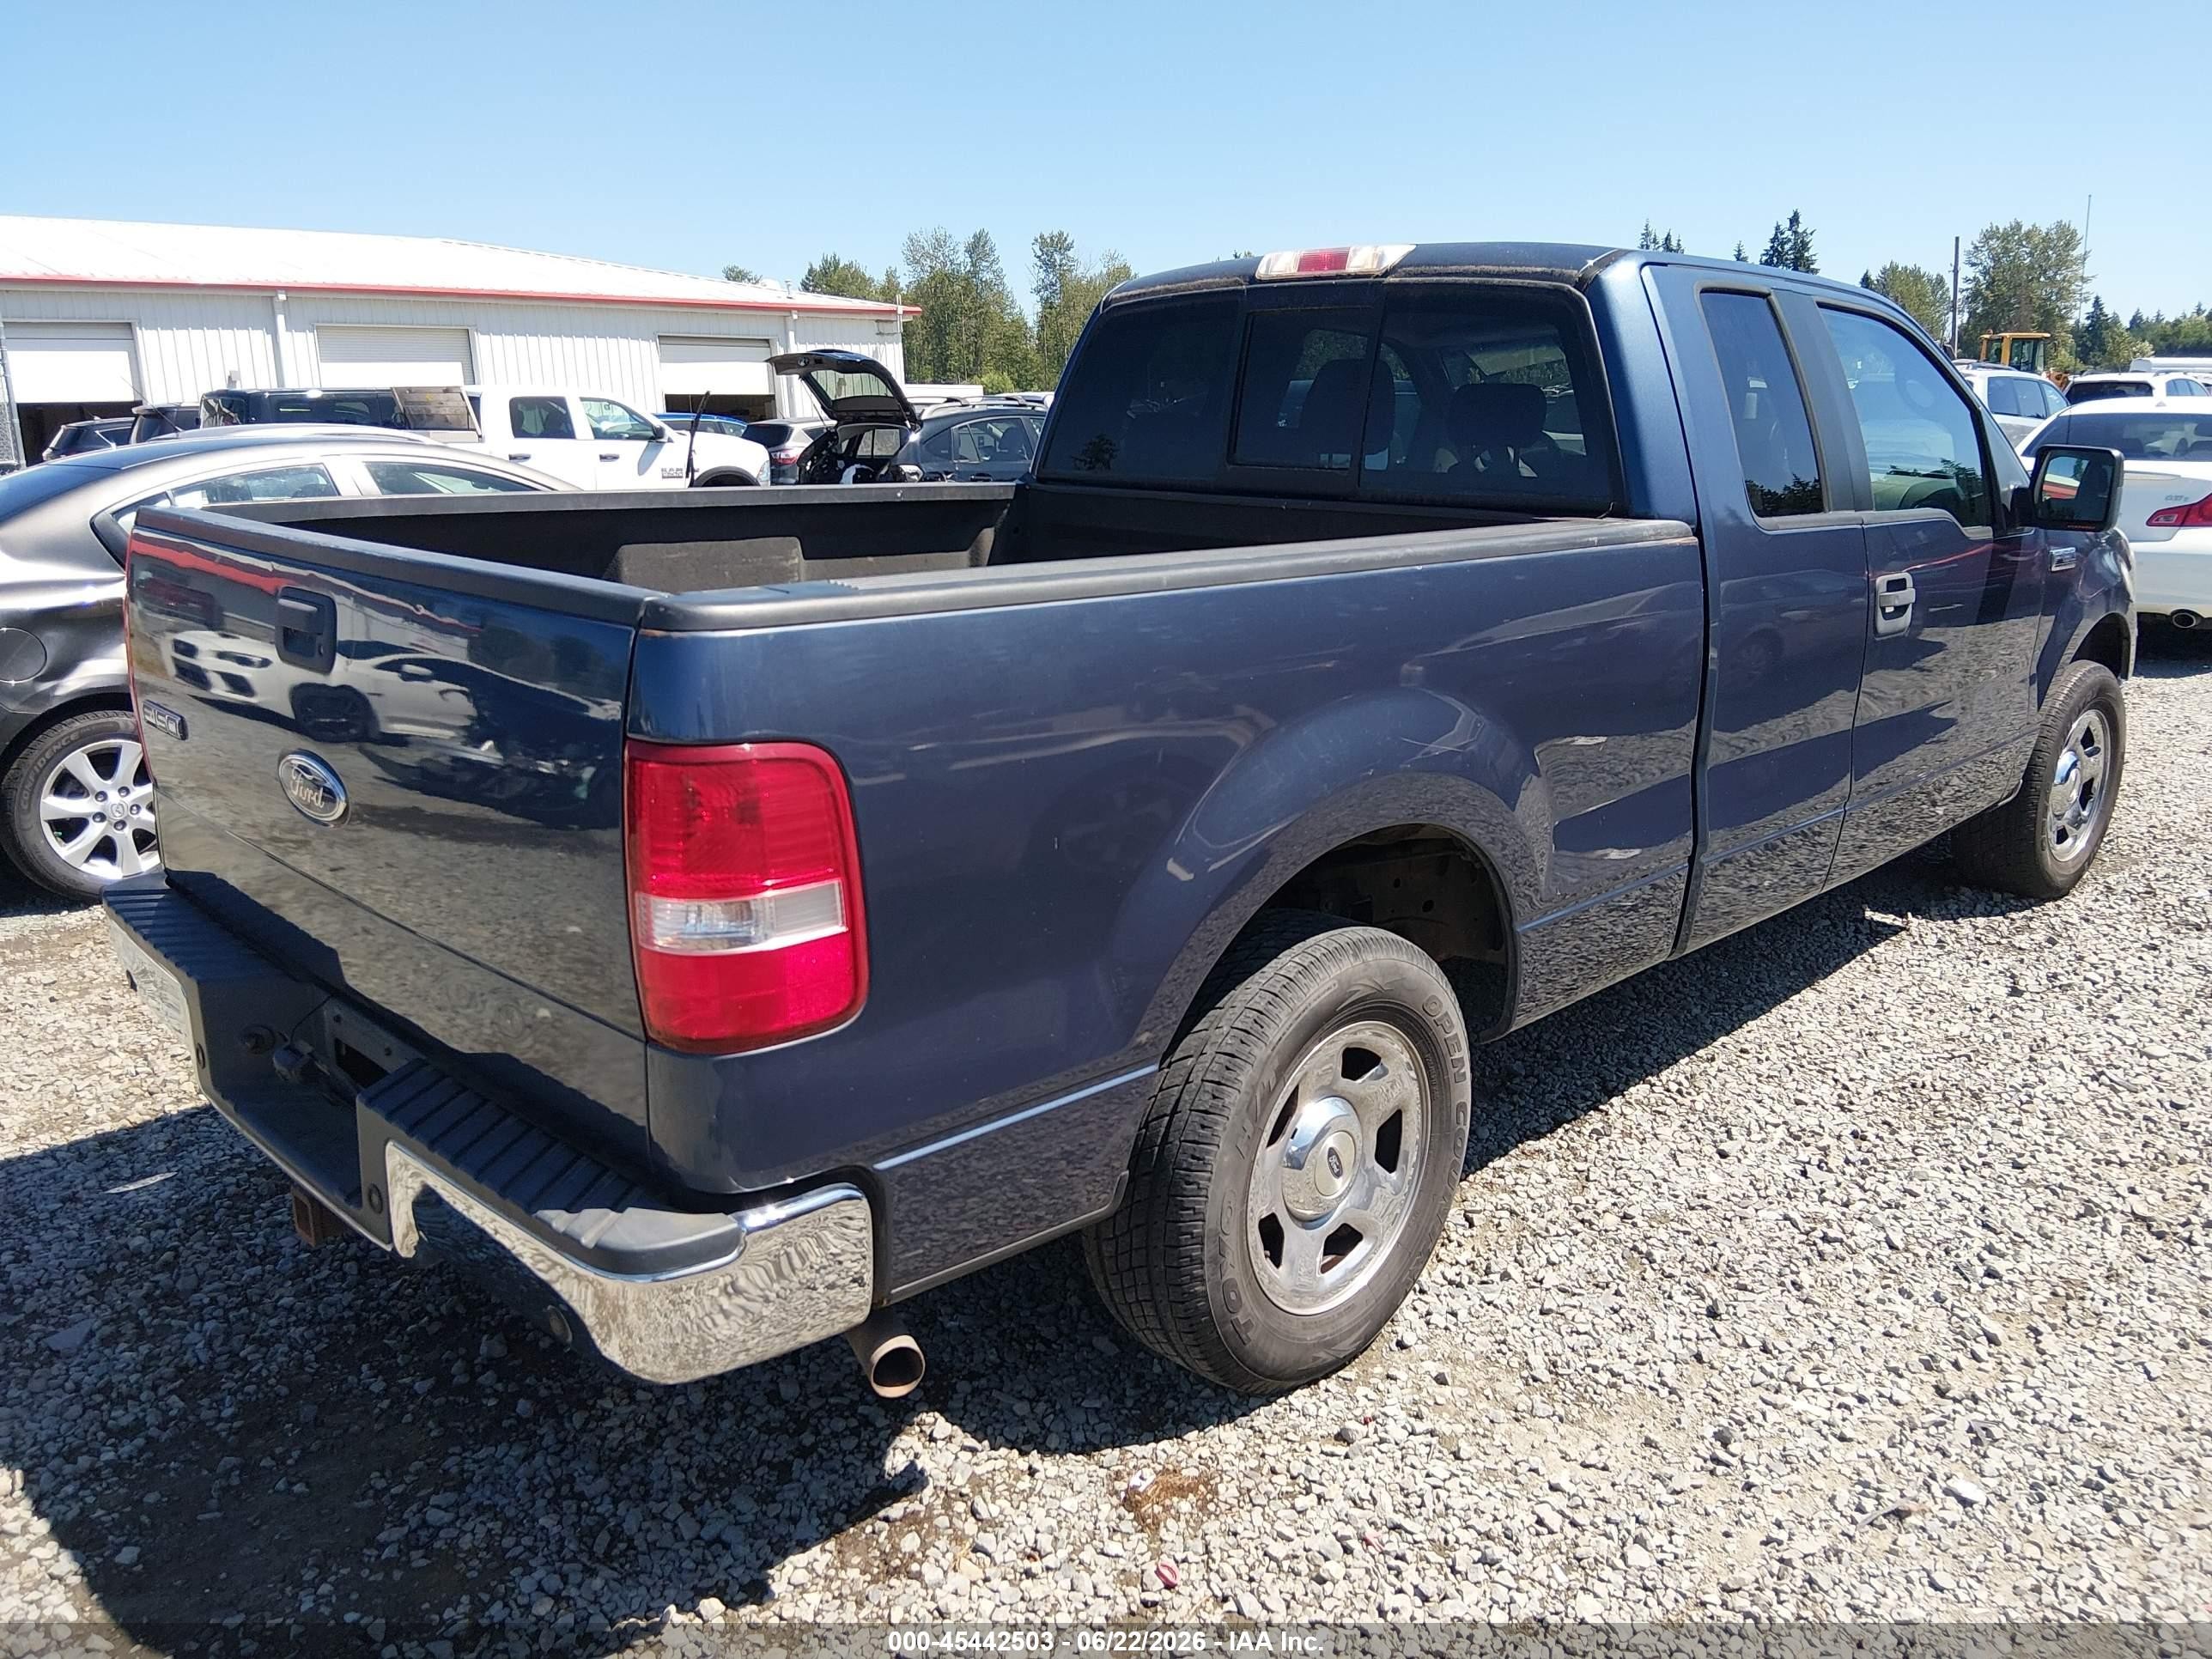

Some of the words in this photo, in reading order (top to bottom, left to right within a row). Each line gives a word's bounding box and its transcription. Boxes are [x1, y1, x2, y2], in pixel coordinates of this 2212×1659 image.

[290, 764, 325, 808] Ford
[1421, 994, 1468, 1085] OPEN
[1218, 1188, 1255, 1346] TOYO
